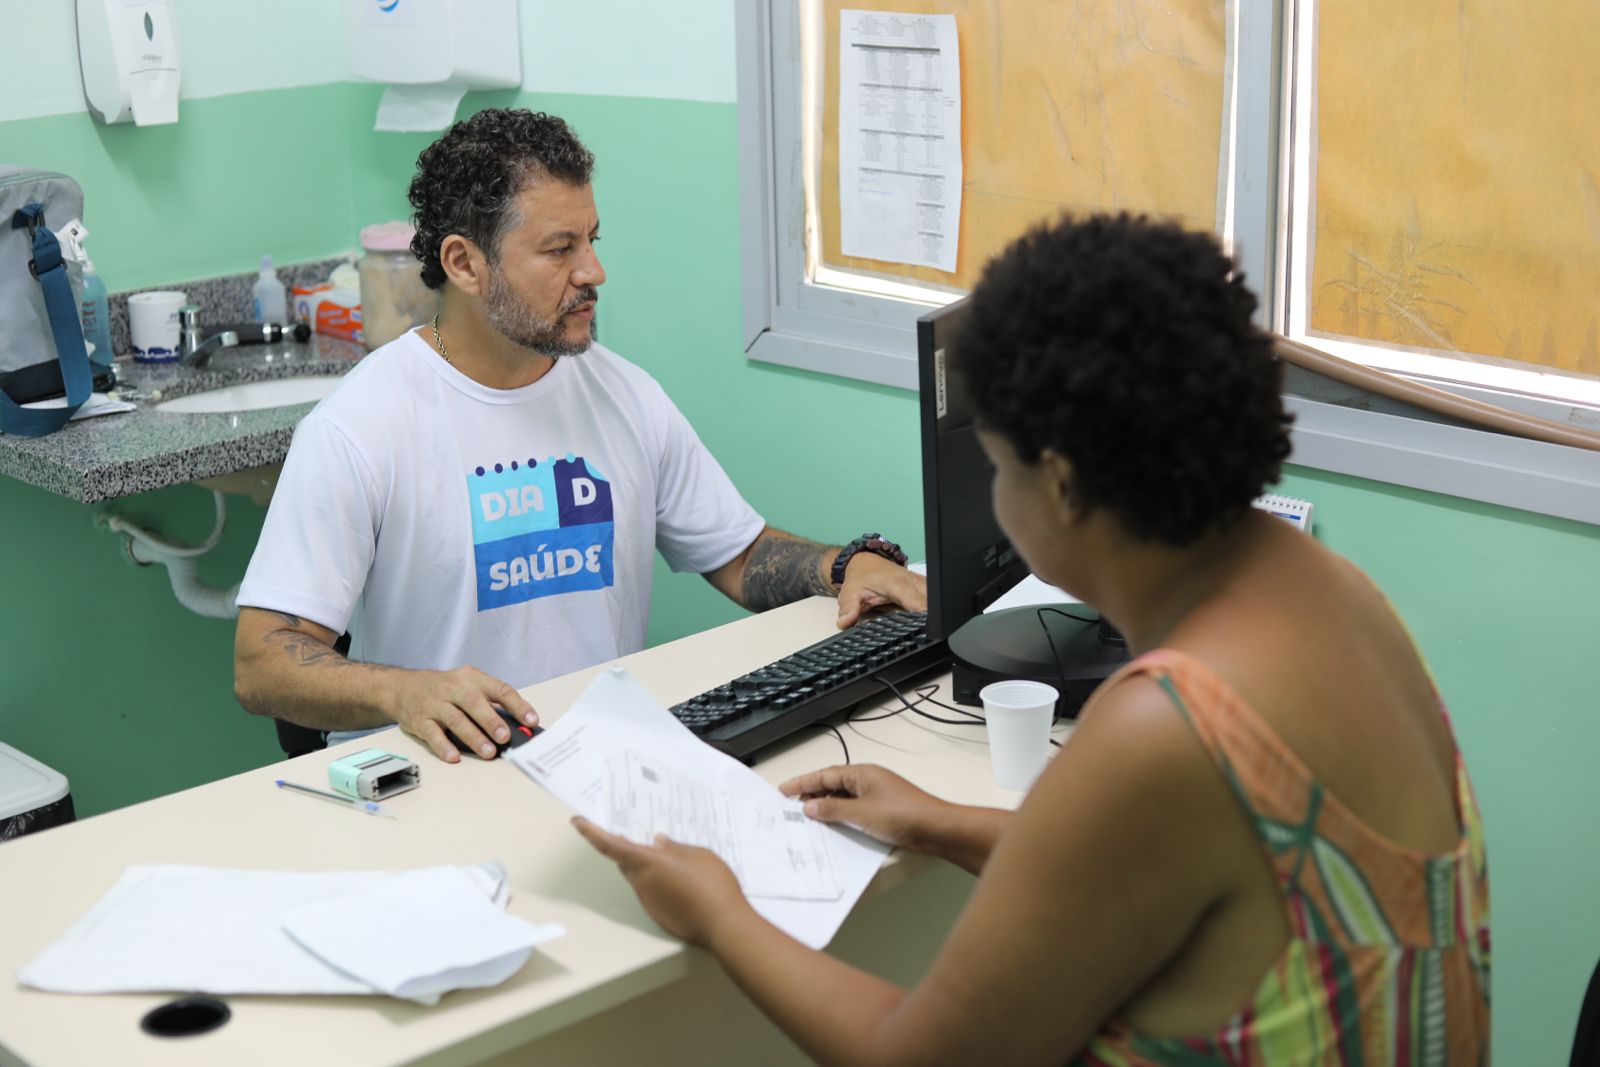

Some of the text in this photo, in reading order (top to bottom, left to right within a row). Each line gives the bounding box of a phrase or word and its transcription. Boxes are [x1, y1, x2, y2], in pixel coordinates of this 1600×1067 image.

[480, 477, 597, 522] DIA D
[489, 543, 602, 591] SAÚDE
